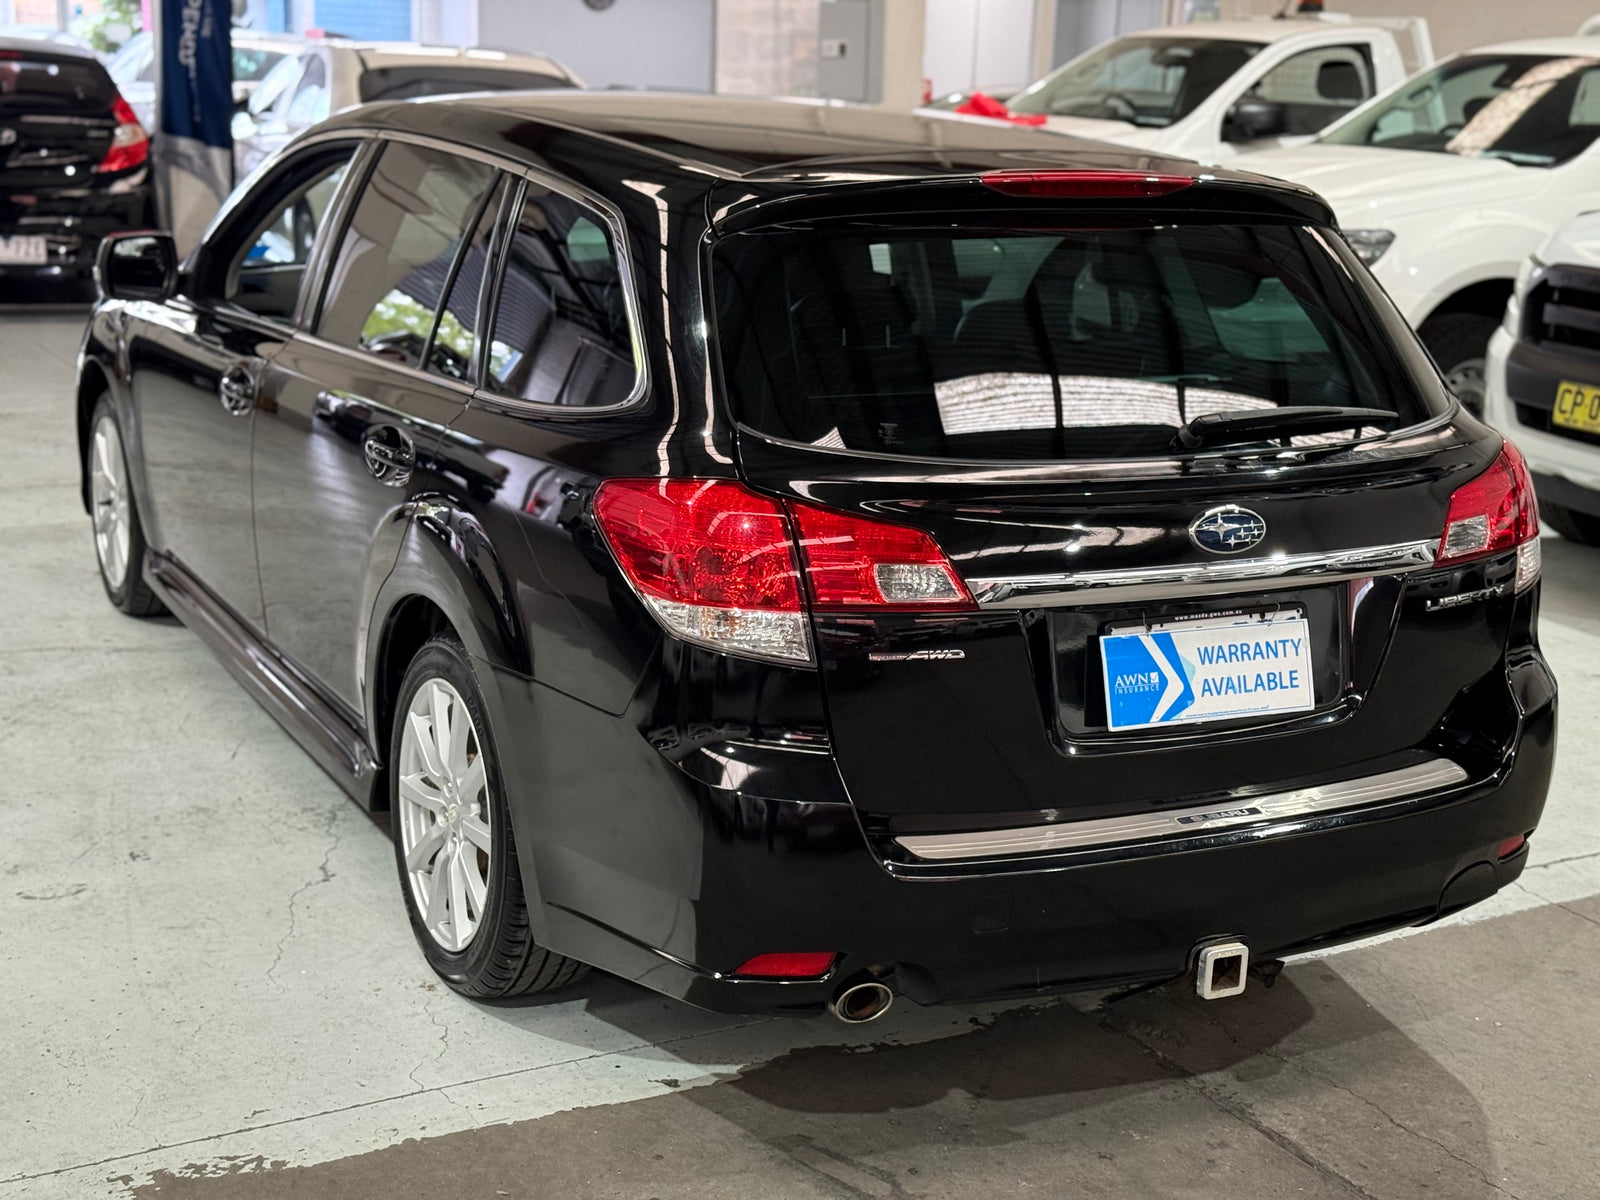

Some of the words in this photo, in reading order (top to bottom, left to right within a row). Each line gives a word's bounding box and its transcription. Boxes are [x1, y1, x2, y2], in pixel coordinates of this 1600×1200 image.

[1558, 388, 1586, 415] CP
[1425, 584, 1505, 612] LIBERTY
[906, 649, 966, 661] AWD
[1197, 637, 1302, 666] WARRANTY
[1114, 684, 1160, 696] INSURANCE
[1115, 672, 1149, 688] AWN
[1200, 669, 1300, 698] AVAILABLE
[1190, 808, 1250, 822] SUBARU
